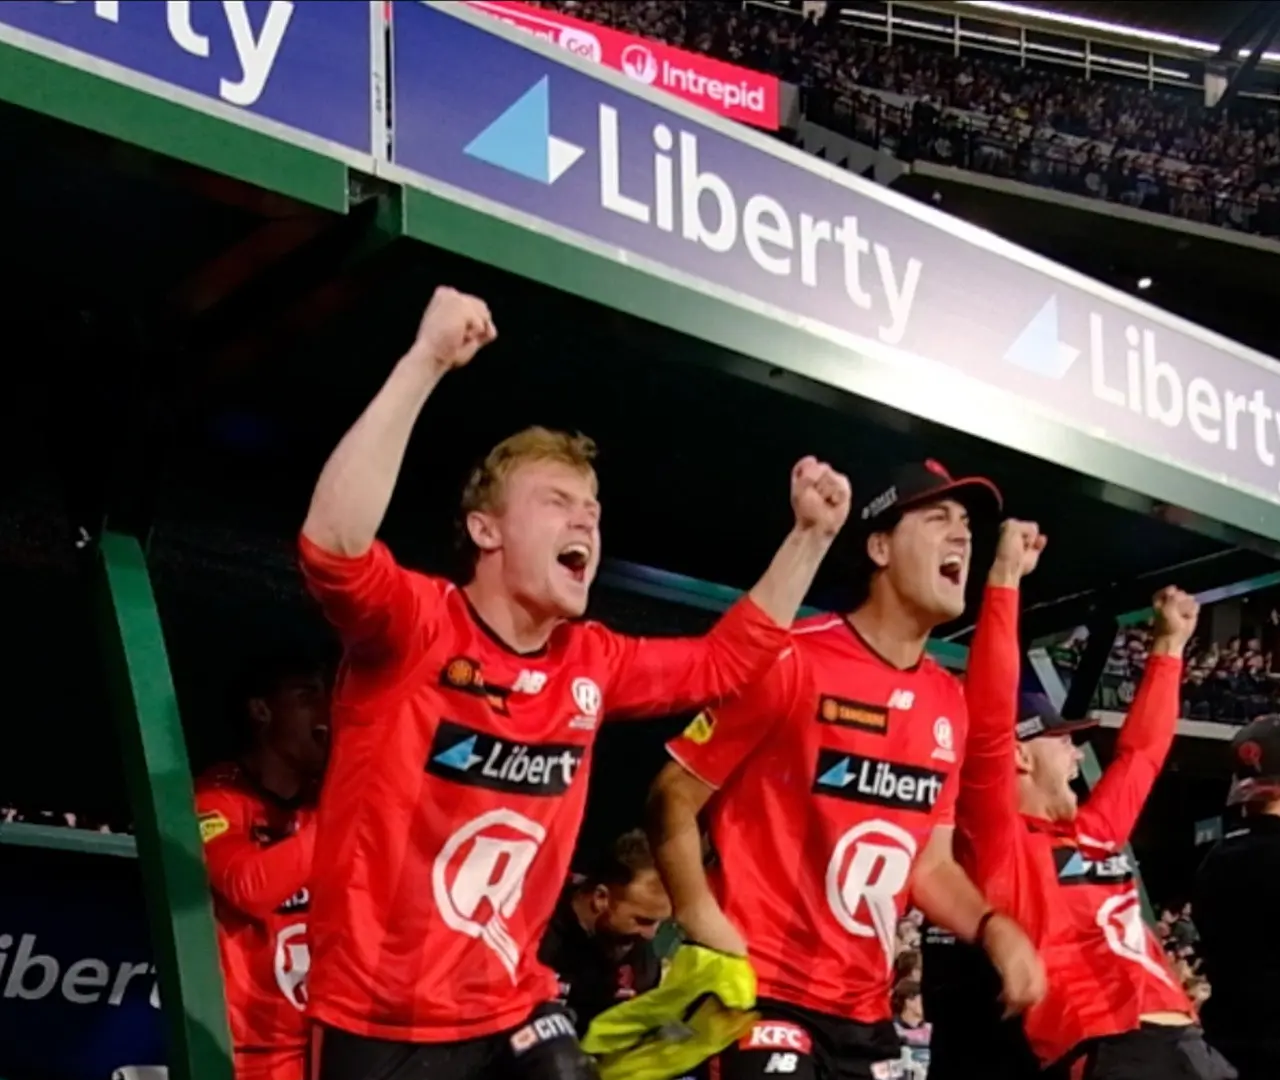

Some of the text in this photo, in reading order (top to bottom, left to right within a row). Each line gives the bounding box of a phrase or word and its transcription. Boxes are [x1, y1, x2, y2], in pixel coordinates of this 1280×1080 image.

[662, 60, 765, 112] Intrepid
[599, 102, 923, 344] Liberty
[482, 741, 582, 785] Libert
[749, 1025, 803, 1049] KFC
